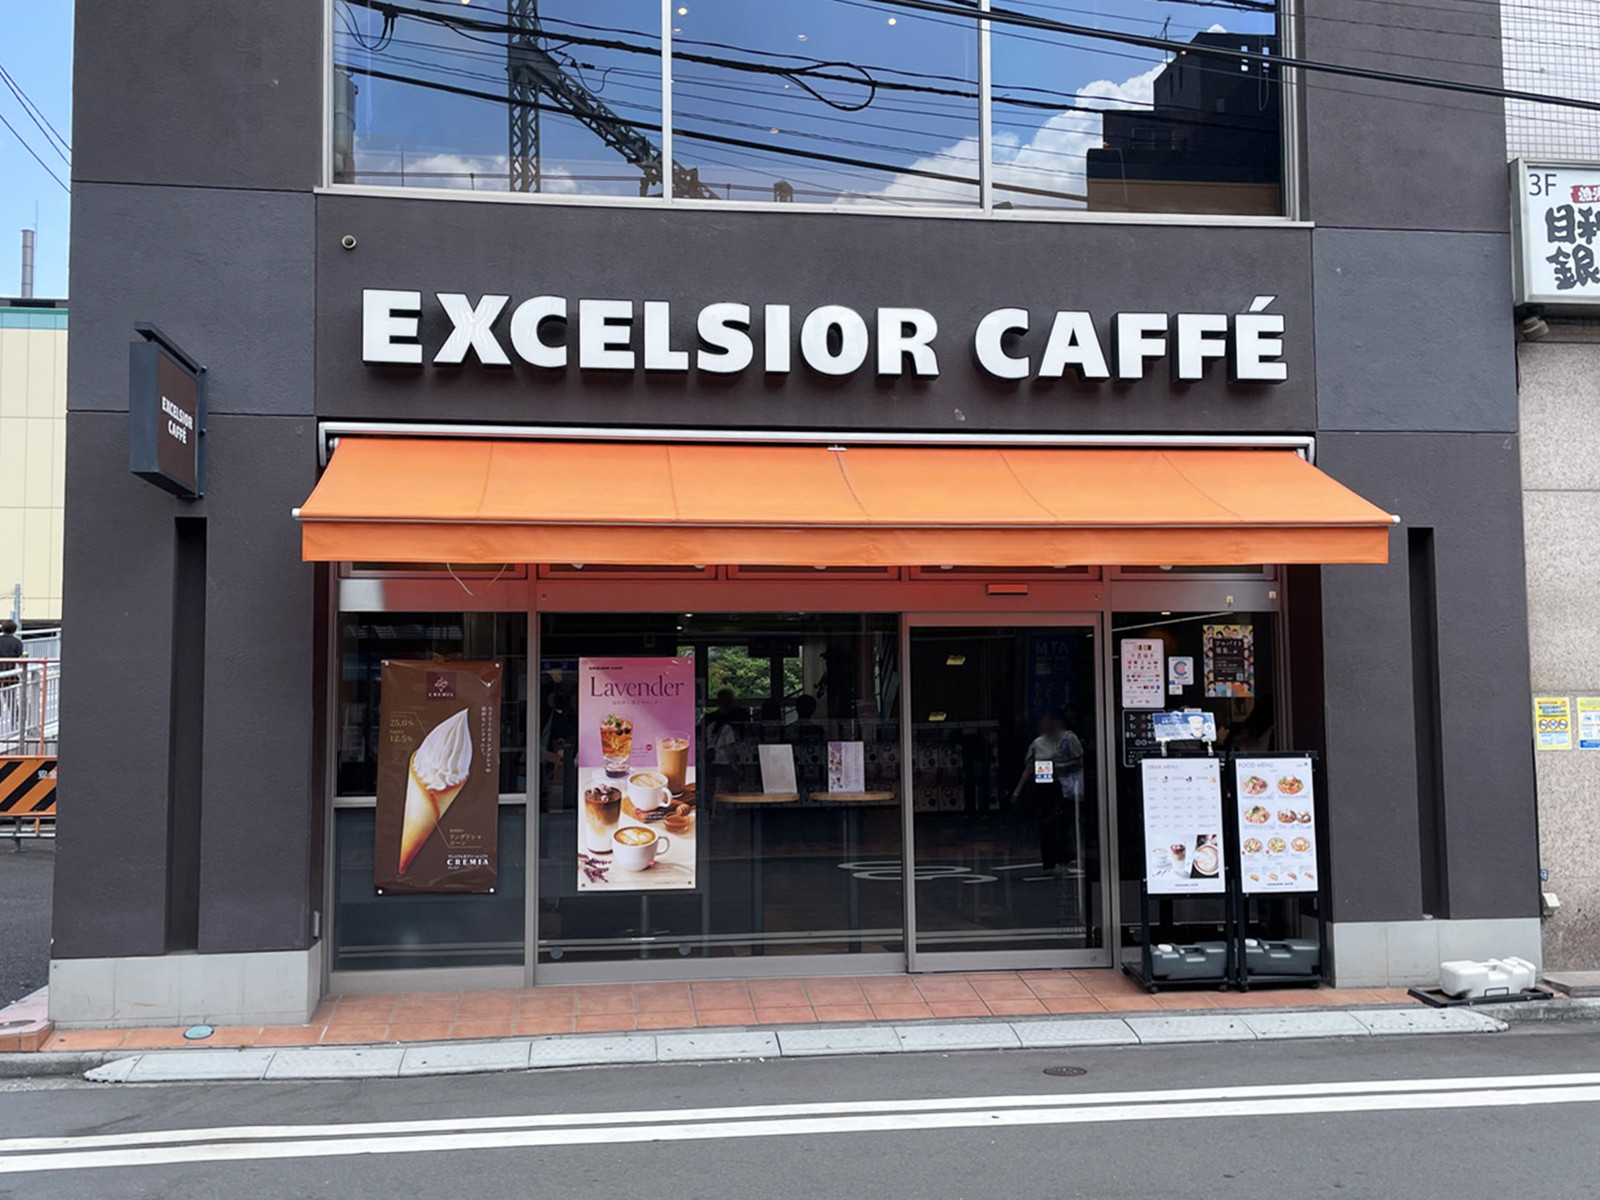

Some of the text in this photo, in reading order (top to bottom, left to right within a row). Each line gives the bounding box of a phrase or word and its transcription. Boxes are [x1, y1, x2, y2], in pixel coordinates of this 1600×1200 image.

[1529, 173, 1557, 196] 3F
[362, 289, 1288, 380] EXCELSIOR CAFFÉ
[161, 396, 193, 430] EXCELSIOR
[167, 420, 187, 444] CAFFÉ
[590, 675, 685, 697] Lavender
